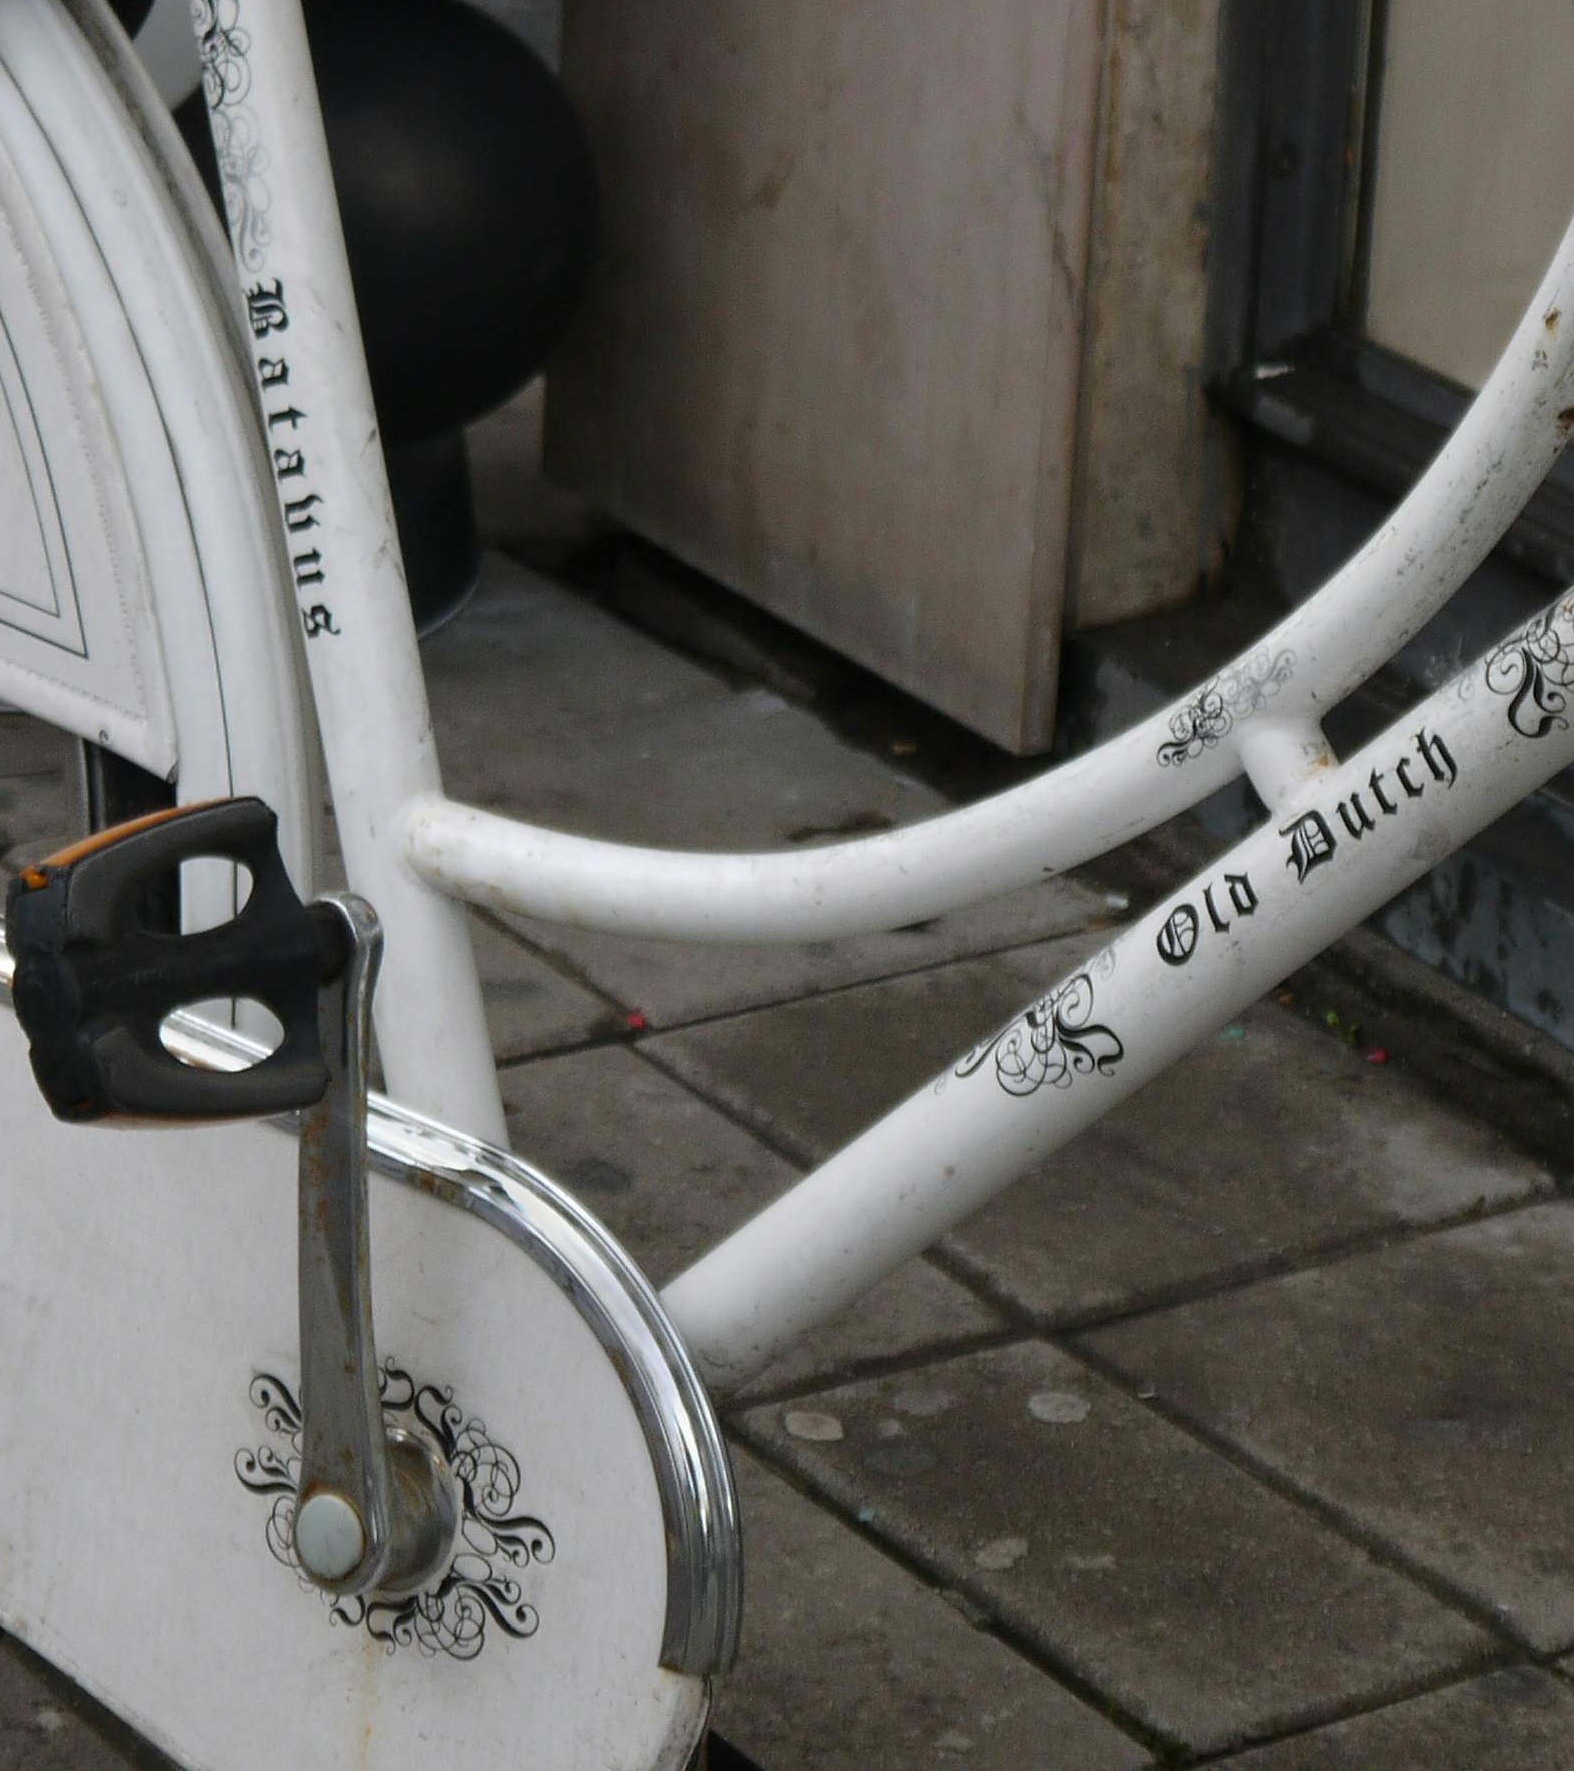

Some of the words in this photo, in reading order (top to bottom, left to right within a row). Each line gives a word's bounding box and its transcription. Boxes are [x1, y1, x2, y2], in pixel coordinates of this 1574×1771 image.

[242, 278, 342, 639] Batavus
[1155, 871, 1260, 968] Old
[1277, 725, 1459, 885] Dutch
